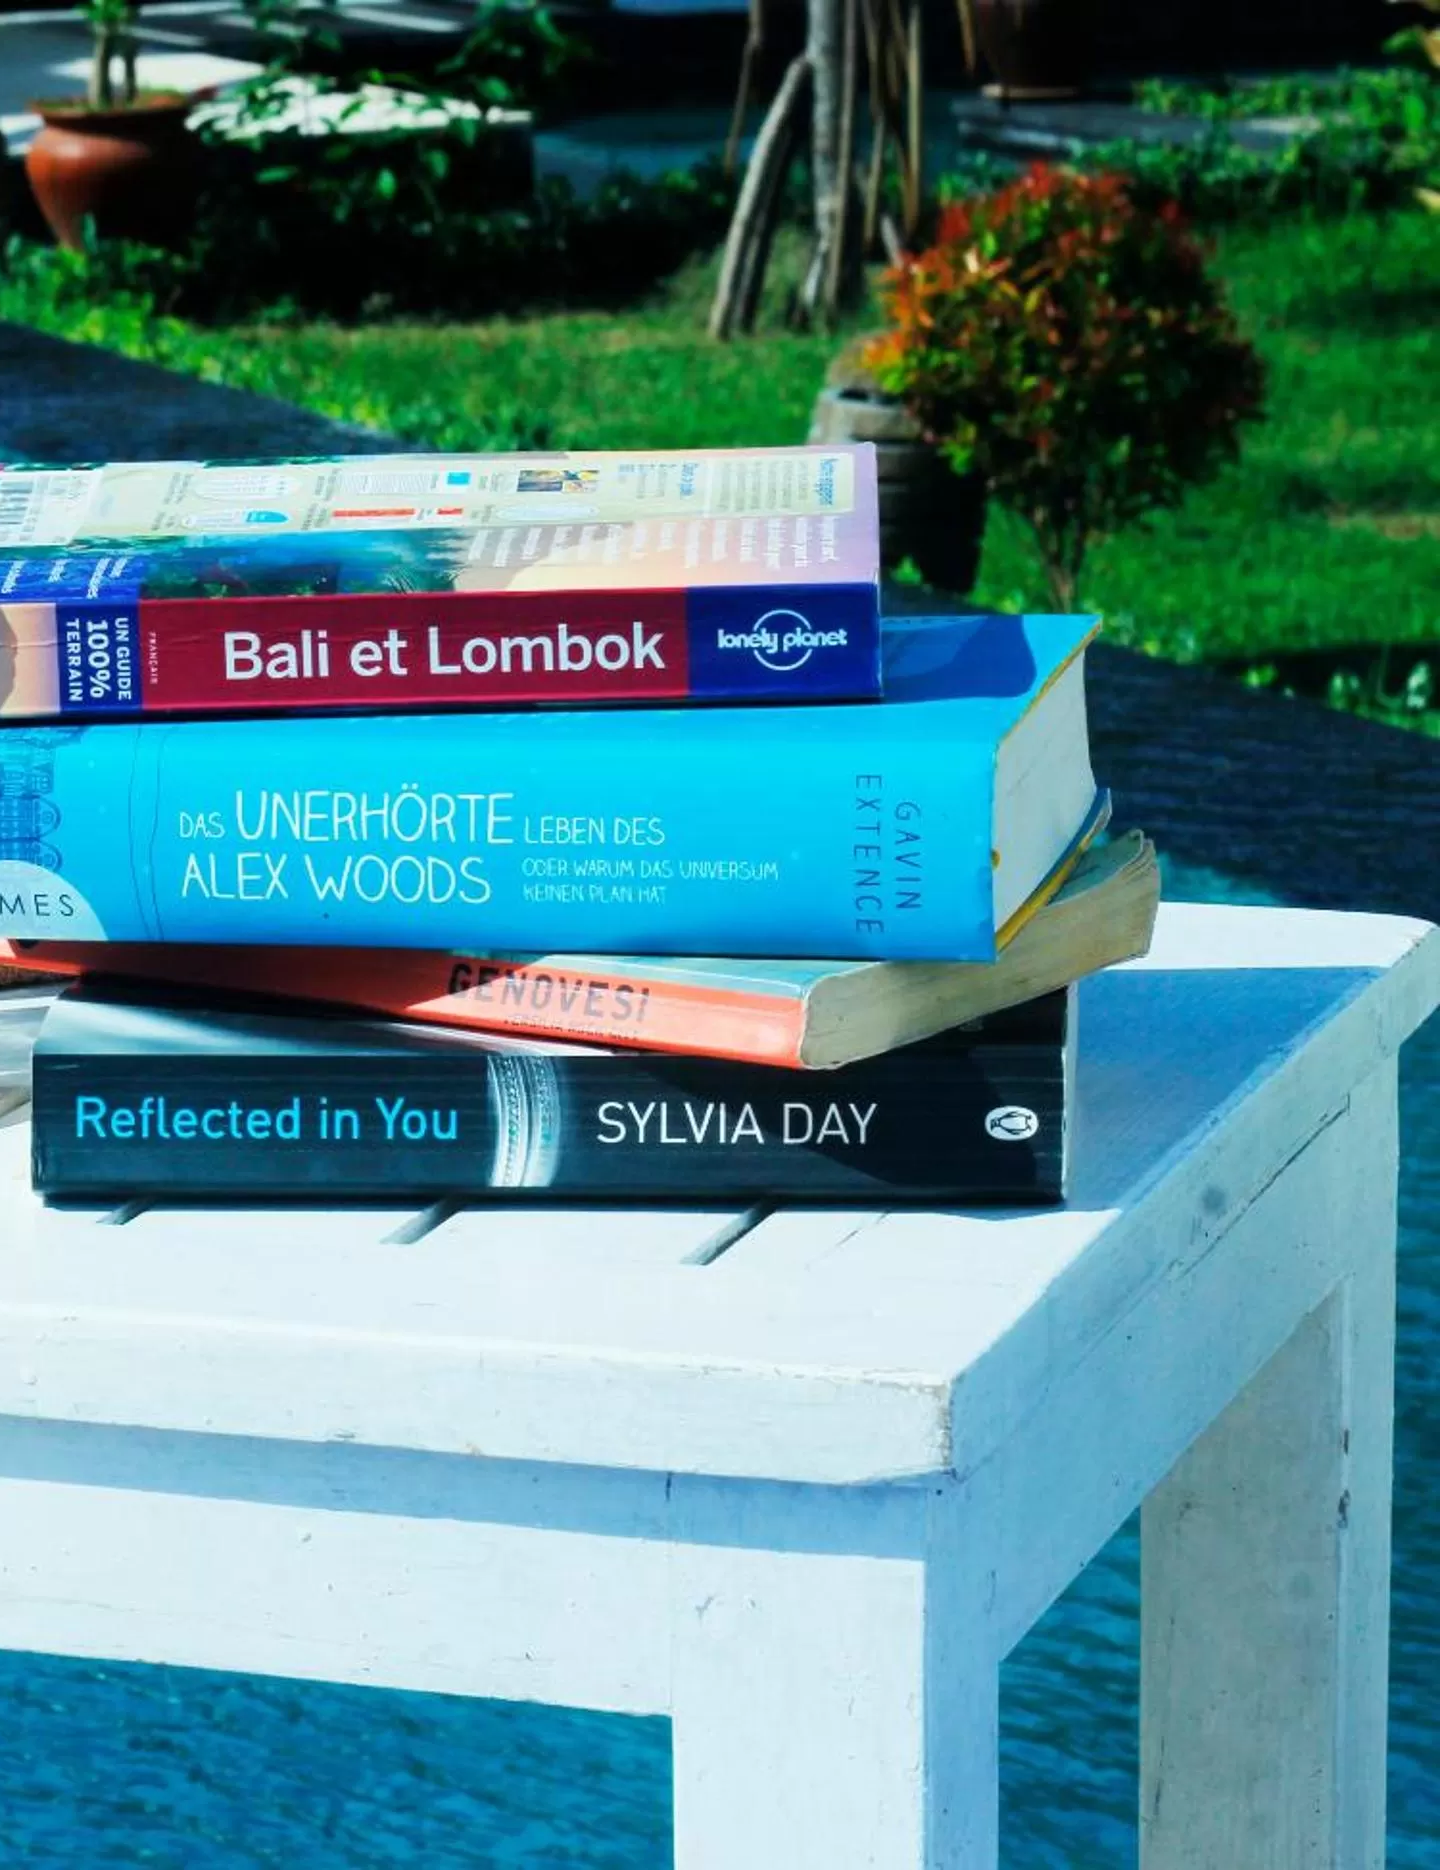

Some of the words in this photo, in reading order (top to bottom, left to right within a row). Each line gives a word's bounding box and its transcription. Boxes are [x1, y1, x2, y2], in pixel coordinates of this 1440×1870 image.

[114, 617, 130, 642] UN
[224, 629, 330, 681] Bali
[349, 630, 408, 678] et
[427, 621, 666, 676] Lombok
[717, 627, 779, 654] lonely
[782, 627, 848, 653] planet
[66, 617, 83, 702] TERRAIN
[87, 619, 112, 698] 100%
[116, 646, 132, 701] GUIDE
[178, 811, 226, 839] DAS
[235, 782, 515, 846] UNERHÖRTE
[523, 815, 607, 845] LEBEN
[613, 816, 666, 846] DES
[181, 851, 290, 901] ALEX
[303, 854, 492, 904] WOODS
[521, 857, 569, 878] ODER
[573, 858, 636, 879] WARUM
[640, 859, 675, 879] DAS
[679, 860, 779, 881] UNIVERSUM
[853, 773, 885, 935] EXTENCE
[893, 800, 923, 911] GAVIN
[523, 883, 586, 904] KEINEN
[588, 883, 633, 904] PLAN
[637, 885, 667, 905] HAT
[448, 963, 651, 1022] GENOVESI
[75, 1095, 301, 1140] Reflected
[319, 1096, 360, 1140] in
[375, 1097, 459, 1140] You
[596, 1101, 766, 1144] SYLVIA
[782, 1102, 879, 1145] DAY
